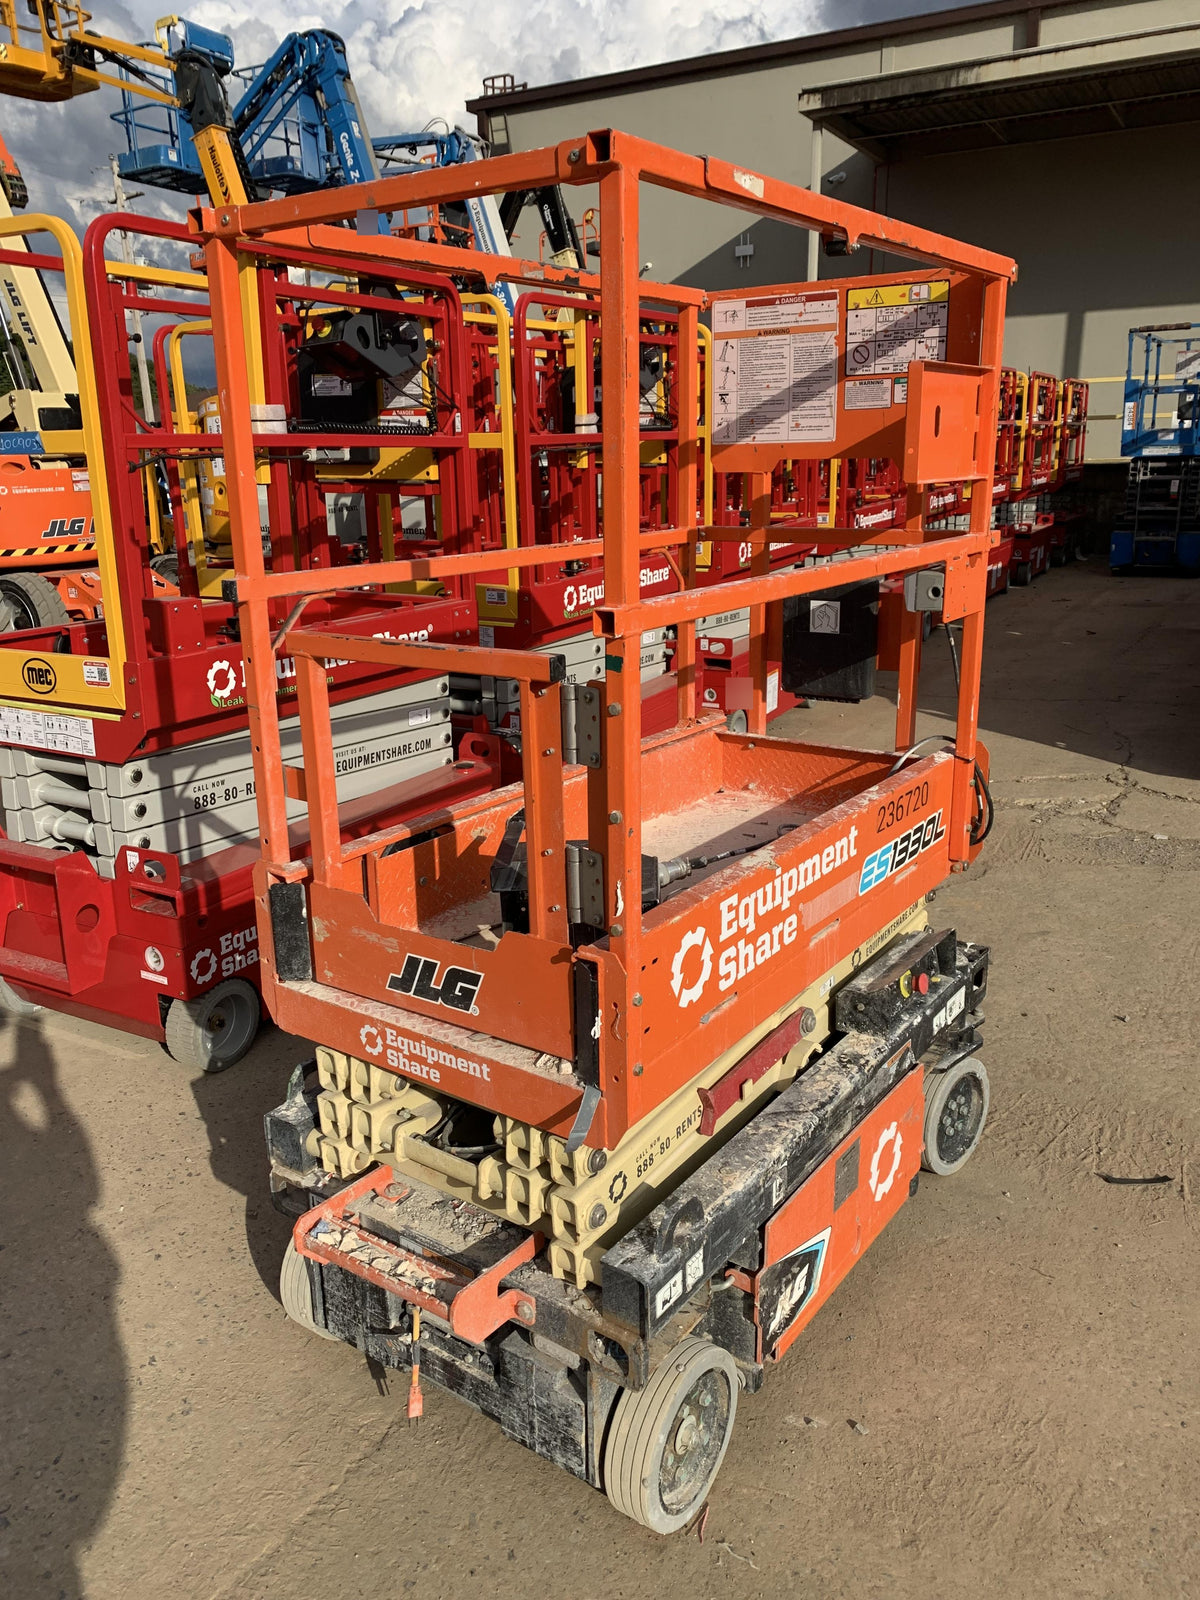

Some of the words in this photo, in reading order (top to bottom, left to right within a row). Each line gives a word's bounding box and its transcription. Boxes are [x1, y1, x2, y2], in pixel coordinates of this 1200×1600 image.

[208, 145, 226, 188] Haulotte
[340, 132, 354, 169] Genie
[4, 279, 22, 307] JLG
[17, 312, 38, 345] LIFT
[781, 296, 807, 304] DANGER
[763, 328, 791, 336] WARNING
[41, 517, 86, 539] JLG
[221, 695, 245, 708] Leak
[336, 738, 432, 773] EQUIPMENTSHARE.COM
[193, 782, 209, 793] CALL
[212, 779, 226, 788] NOW
[876, 781, 929, 834] 236720
[859, 808, 946, 896] ES1330L
[719, 825, 859, 943] Equipment
[865, 901, 919, 957] EQUIPMENTSHARE.COM
[718, 912, 798, 992] Share
[386, 952, 485, 1014] JLG
[384, 1027, 491, 1082] Equipment
[386, 1048, 441, 1083] Share
[636, 1105, 702, 1178] 888-80-RENTS
[636, 1148, 649, 1163] CALL
[650, 1136, 661, 1149] NOW
